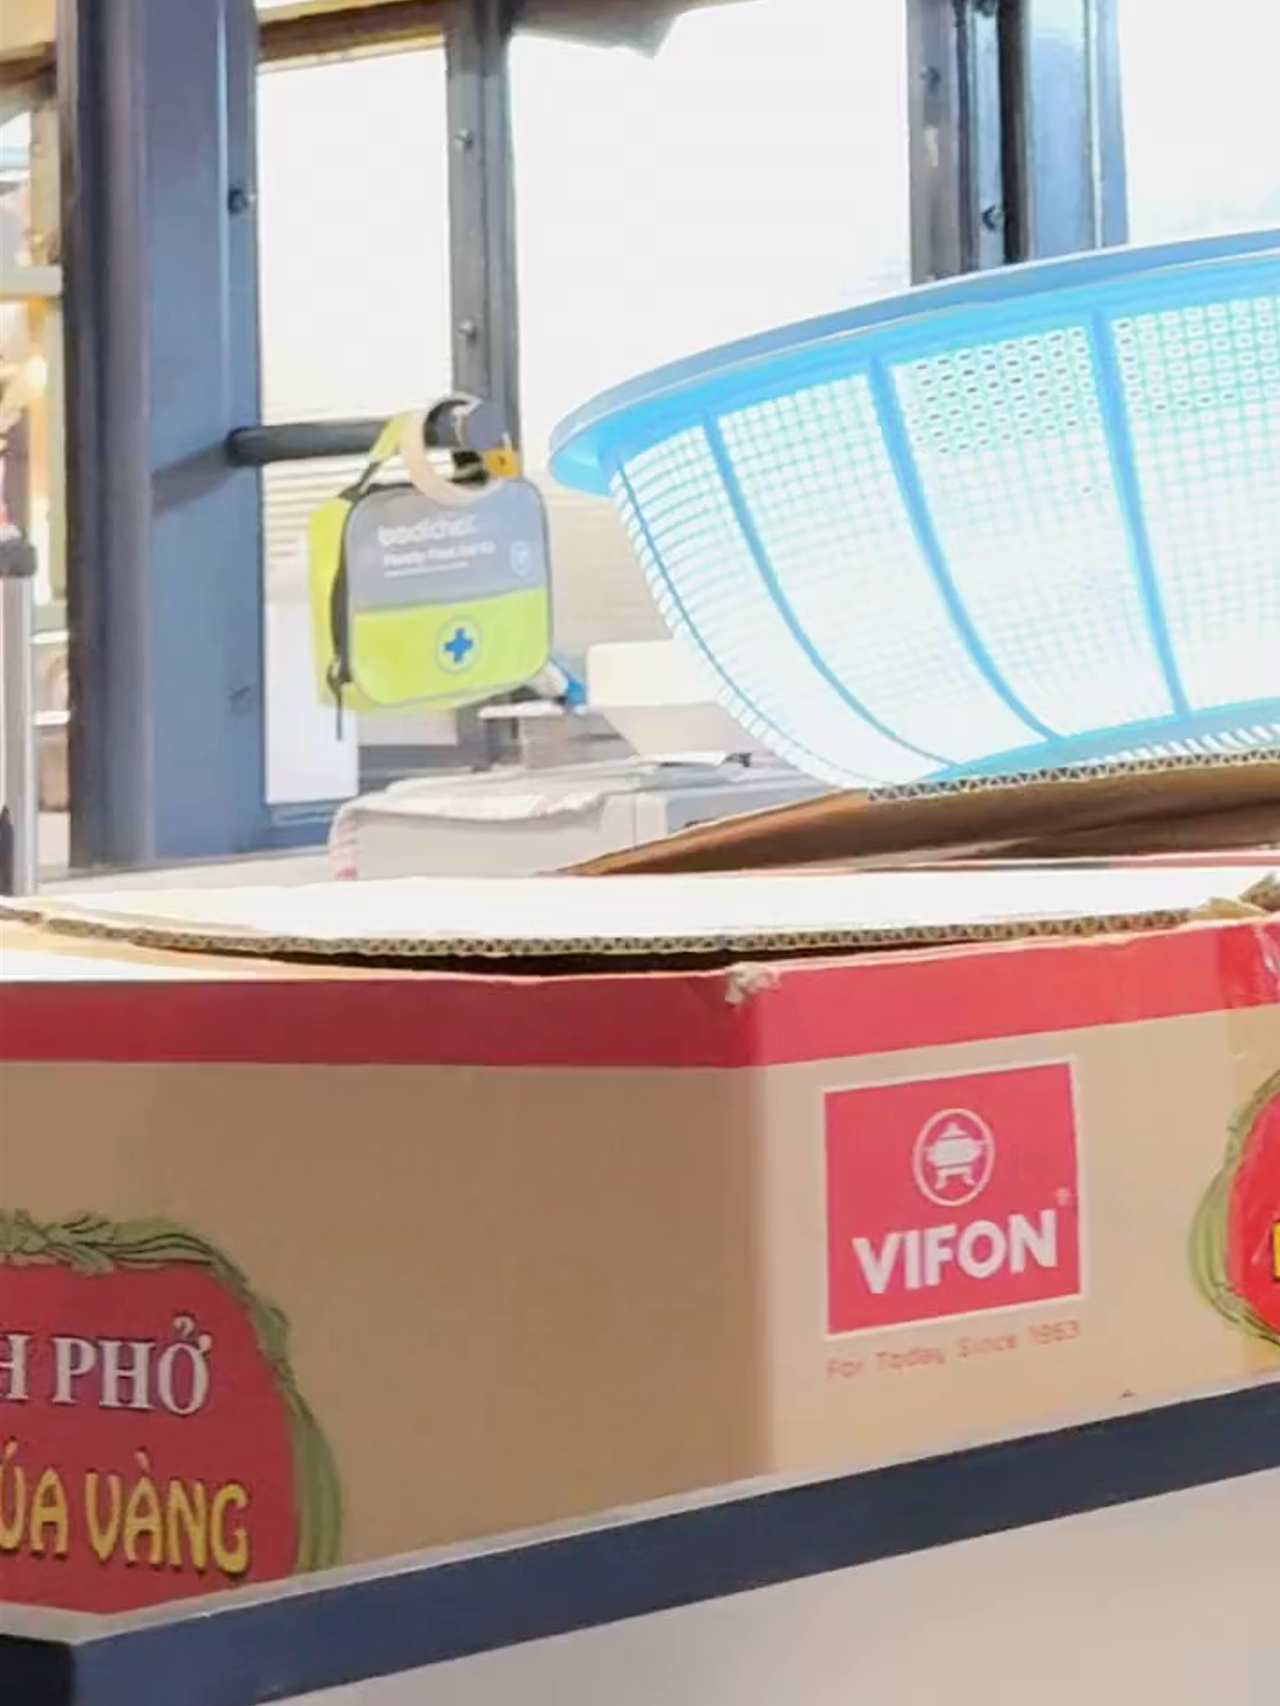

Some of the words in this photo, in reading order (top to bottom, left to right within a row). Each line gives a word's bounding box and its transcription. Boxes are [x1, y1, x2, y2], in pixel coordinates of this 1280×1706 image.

[851, 1208, 1057, 1295] VIFON
[52, 1314, 213, 1415] PHỞ
[0, 1439, 69, 1559] ÚA
[84, 1448, 250, 1574] VÀNG
